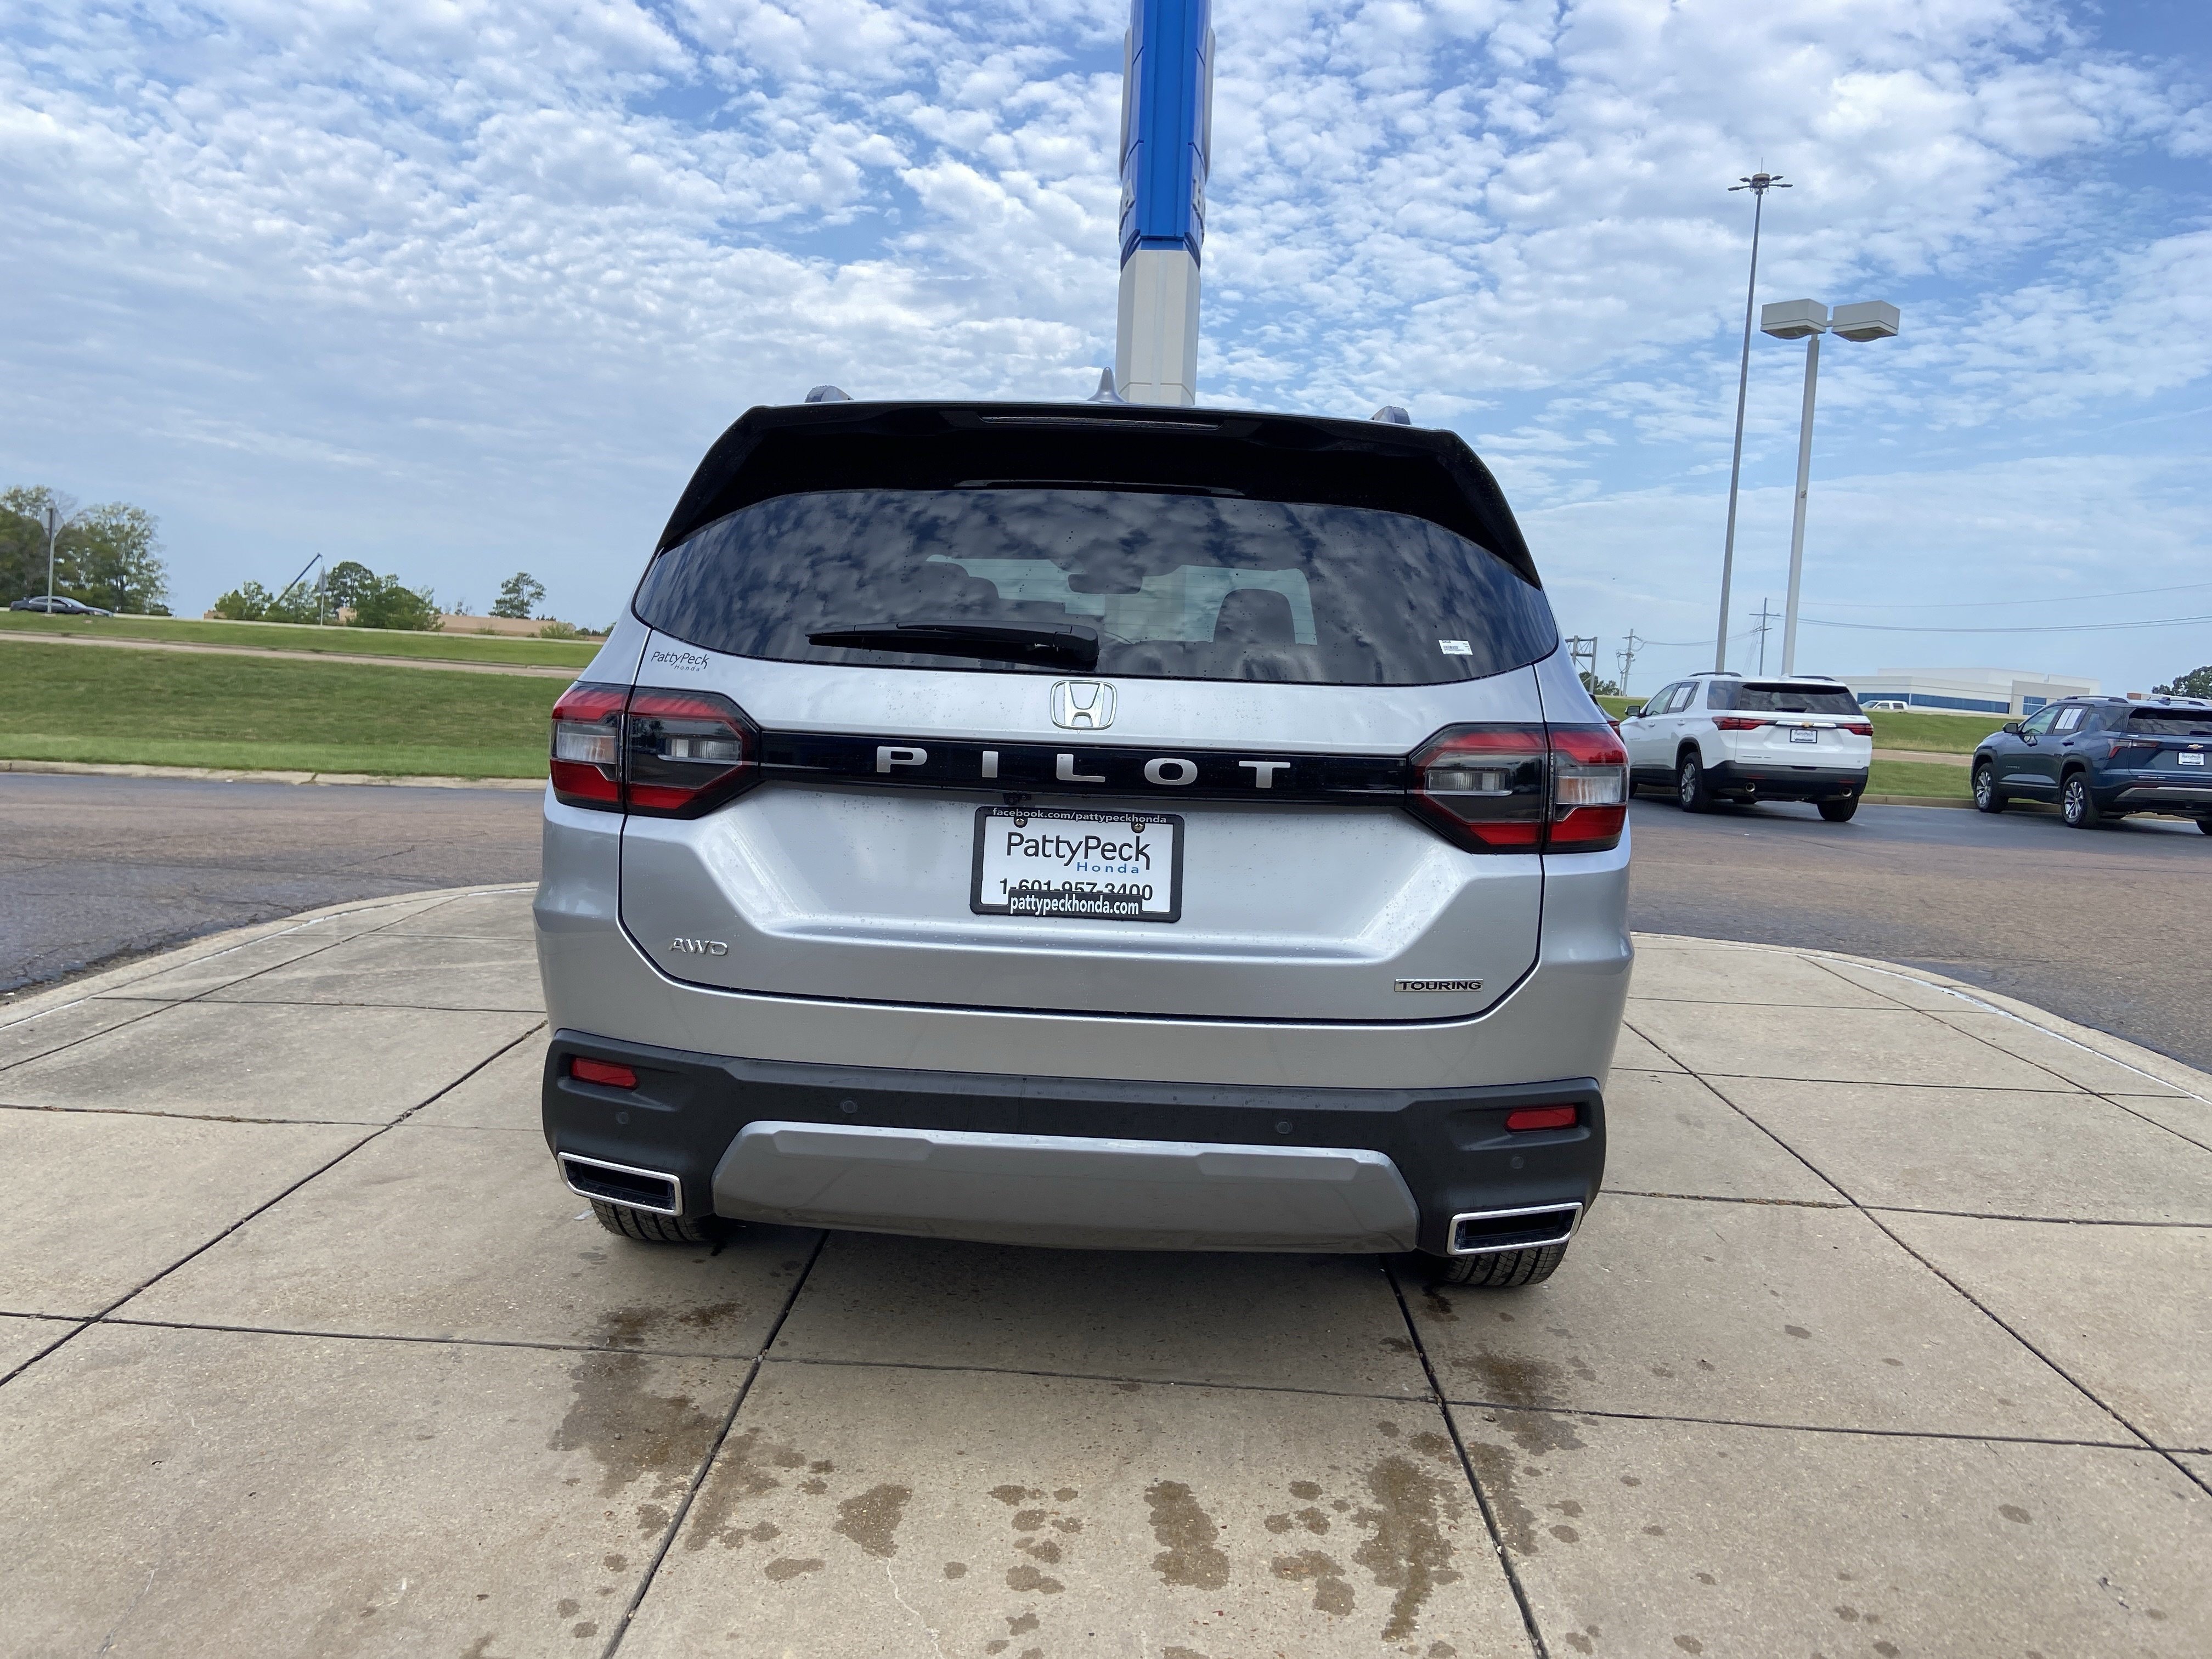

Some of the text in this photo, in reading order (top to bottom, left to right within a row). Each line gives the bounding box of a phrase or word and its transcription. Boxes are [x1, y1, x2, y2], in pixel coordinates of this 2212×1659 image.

[651, 651, 710, 669] PattyPeck
[877, 746, 1291, 788] PILOT
[992, 808, 1167, 823] facebook.com/pattypeckhonda
[1006, 831, 1151, 870] PattyPeck
[1076, 862, 1139, 874] Honda
[1009, 893, 1139, 916] pattypeckhonda.com
[668, 937, 729, 956] AWD
[1399, 981, 1482, 990] TOURING
